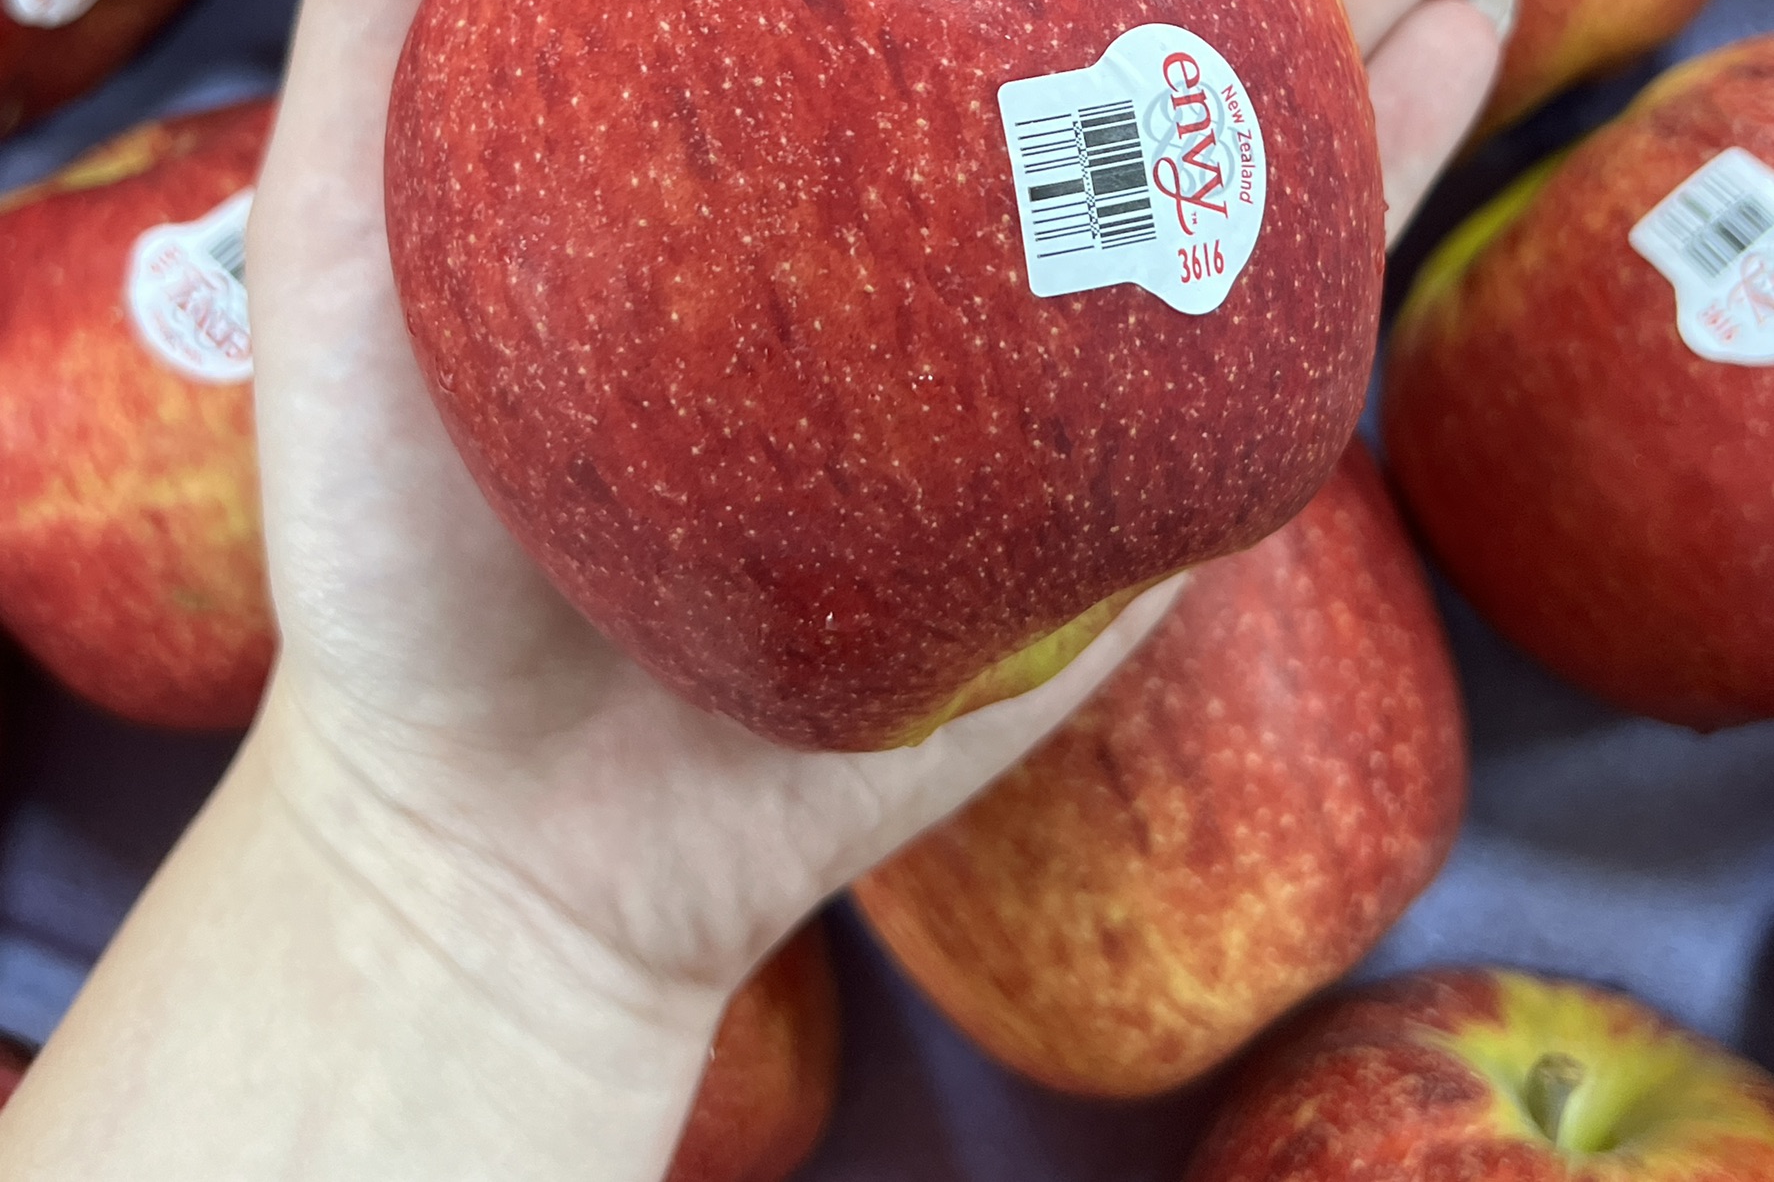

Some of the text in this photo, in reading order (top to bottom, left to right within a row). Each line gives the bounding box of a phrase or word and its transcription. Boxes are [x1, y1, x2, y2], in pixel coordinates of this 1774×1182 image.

[1153, 51, 1229, 236] envy
[1220, 84, 1256, 205] New Zealand
[1177, 239, 1225, 284] 3616
